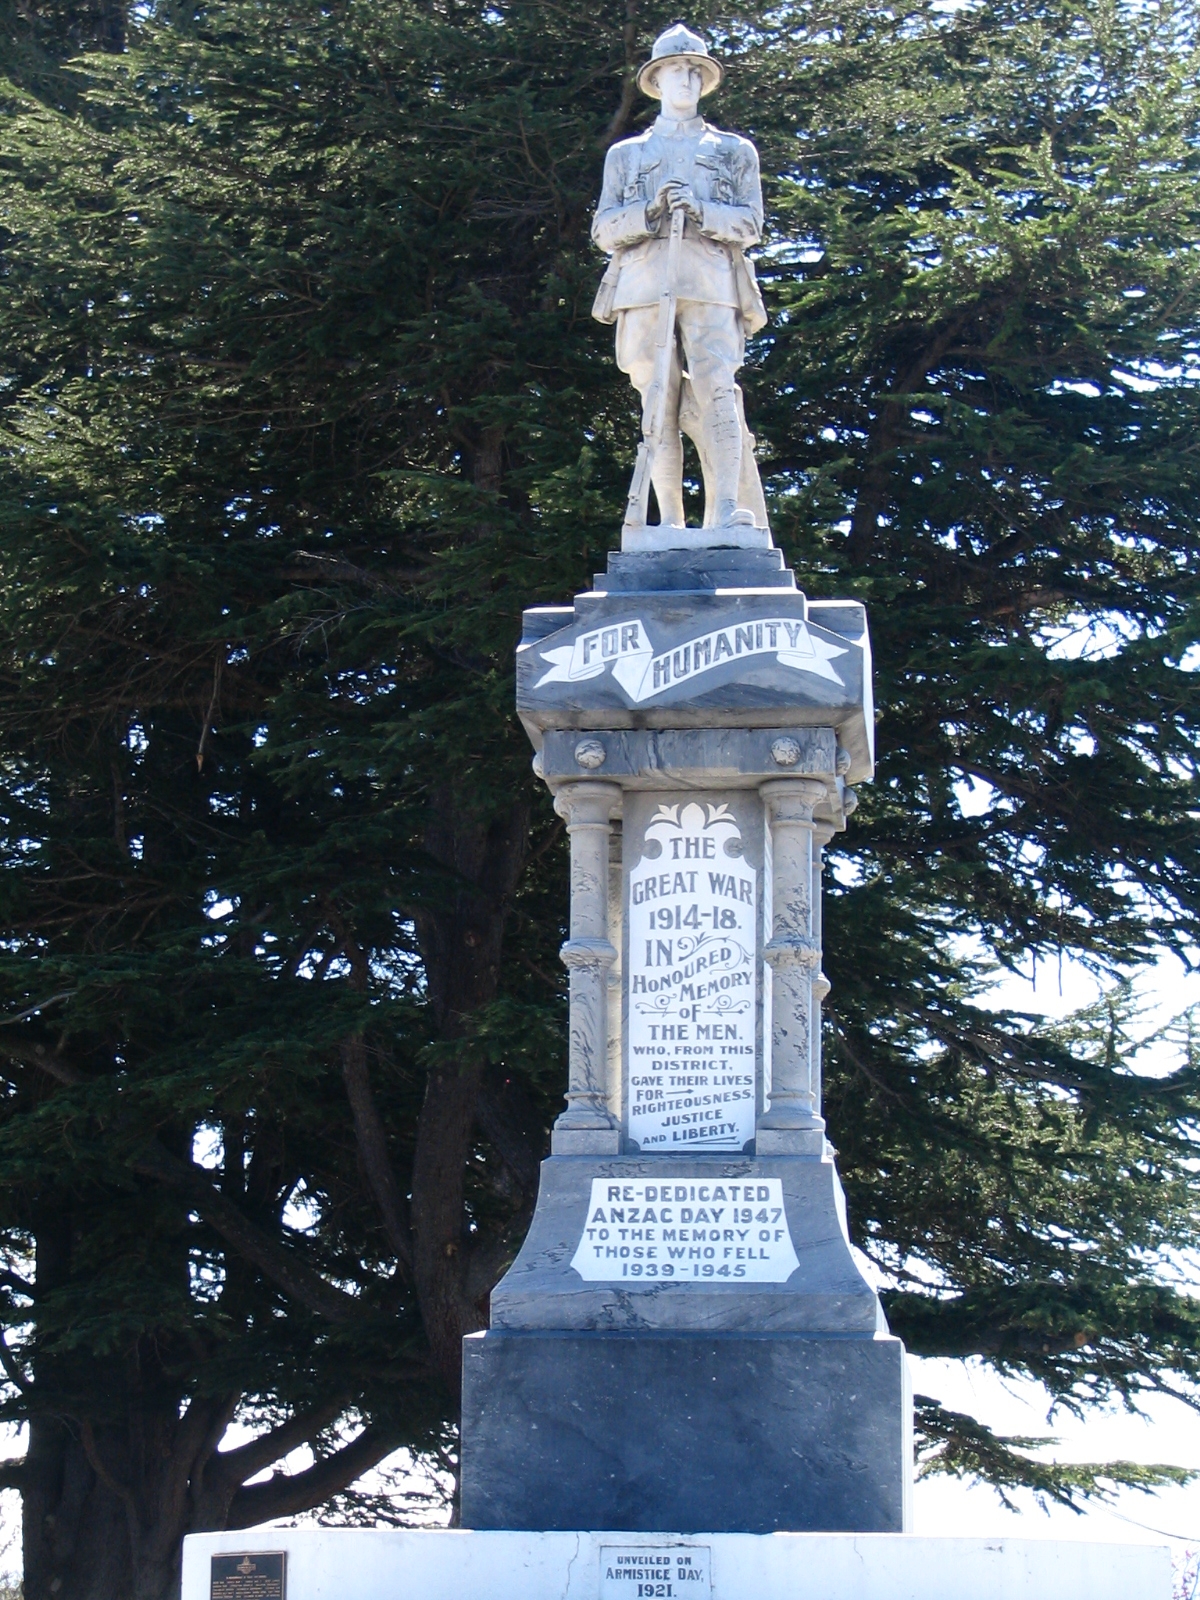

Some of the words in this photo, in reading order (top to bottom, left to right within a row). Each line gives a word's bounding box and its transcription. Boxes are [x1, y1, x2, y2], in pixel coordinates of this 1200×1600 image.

[583, 623, 639, 665] FOR
[653, 621, 803, 689] HUMANITY
[669, 837, 716, 860] THE
[632, 871, 698, 906] GREAT
[708, 872, 753, 906] WAR
[644, 939, 674, 967] IN
[632, 947, 732, 994] HONOURED
[679, 971, 753, 1002] MEMORY
[648, 1024, 689, 1041] THE
[632, 1046, 671, 1056] WHO,
[674, 1046, 714, 1055] FROM
[720, 1046, 754, 1055] THIS
[651, 1060, 733, 1071] DISTRICT,
[631, 1076, 664, 1086] GAVE
[669, 1076, 708, 1086] THEIR
[713, 1075, 753, 1086] LIVES
[636, 1089, 665, 1102] FOR
[661, 1109, 723, 1127] JUSTICE
[642, 1134, 667, 1145] AND
[672, 1122, 740, 1142] LIBERTY.
[607, 1186, 770, 1202] RE-DEDICATED
[591, 1208, 673, 1224] ANZAC
[680, 1208, 725, 1224] DAY
[733, 1208, 783, 1224] 1947
[586, 1229, 610, 1241] TO
[618, 1229, 655, 1241] THE
[662, 1229, 750, 1242] MEMORY
[758, 1229, 785, 1242] OF
[593, 1246, 658, 1259] THOSE
[667, 1246, 715, 1259] WHO
[723, 1247, 770, 1259] FELL
[617, 1556, 671, 1565] UNVEILED
[676, 1556, 692, 1566] ON
[605, 1567, 671, 1580] ARMISTICE
[637, 1583, 677, 1597] 1921.
